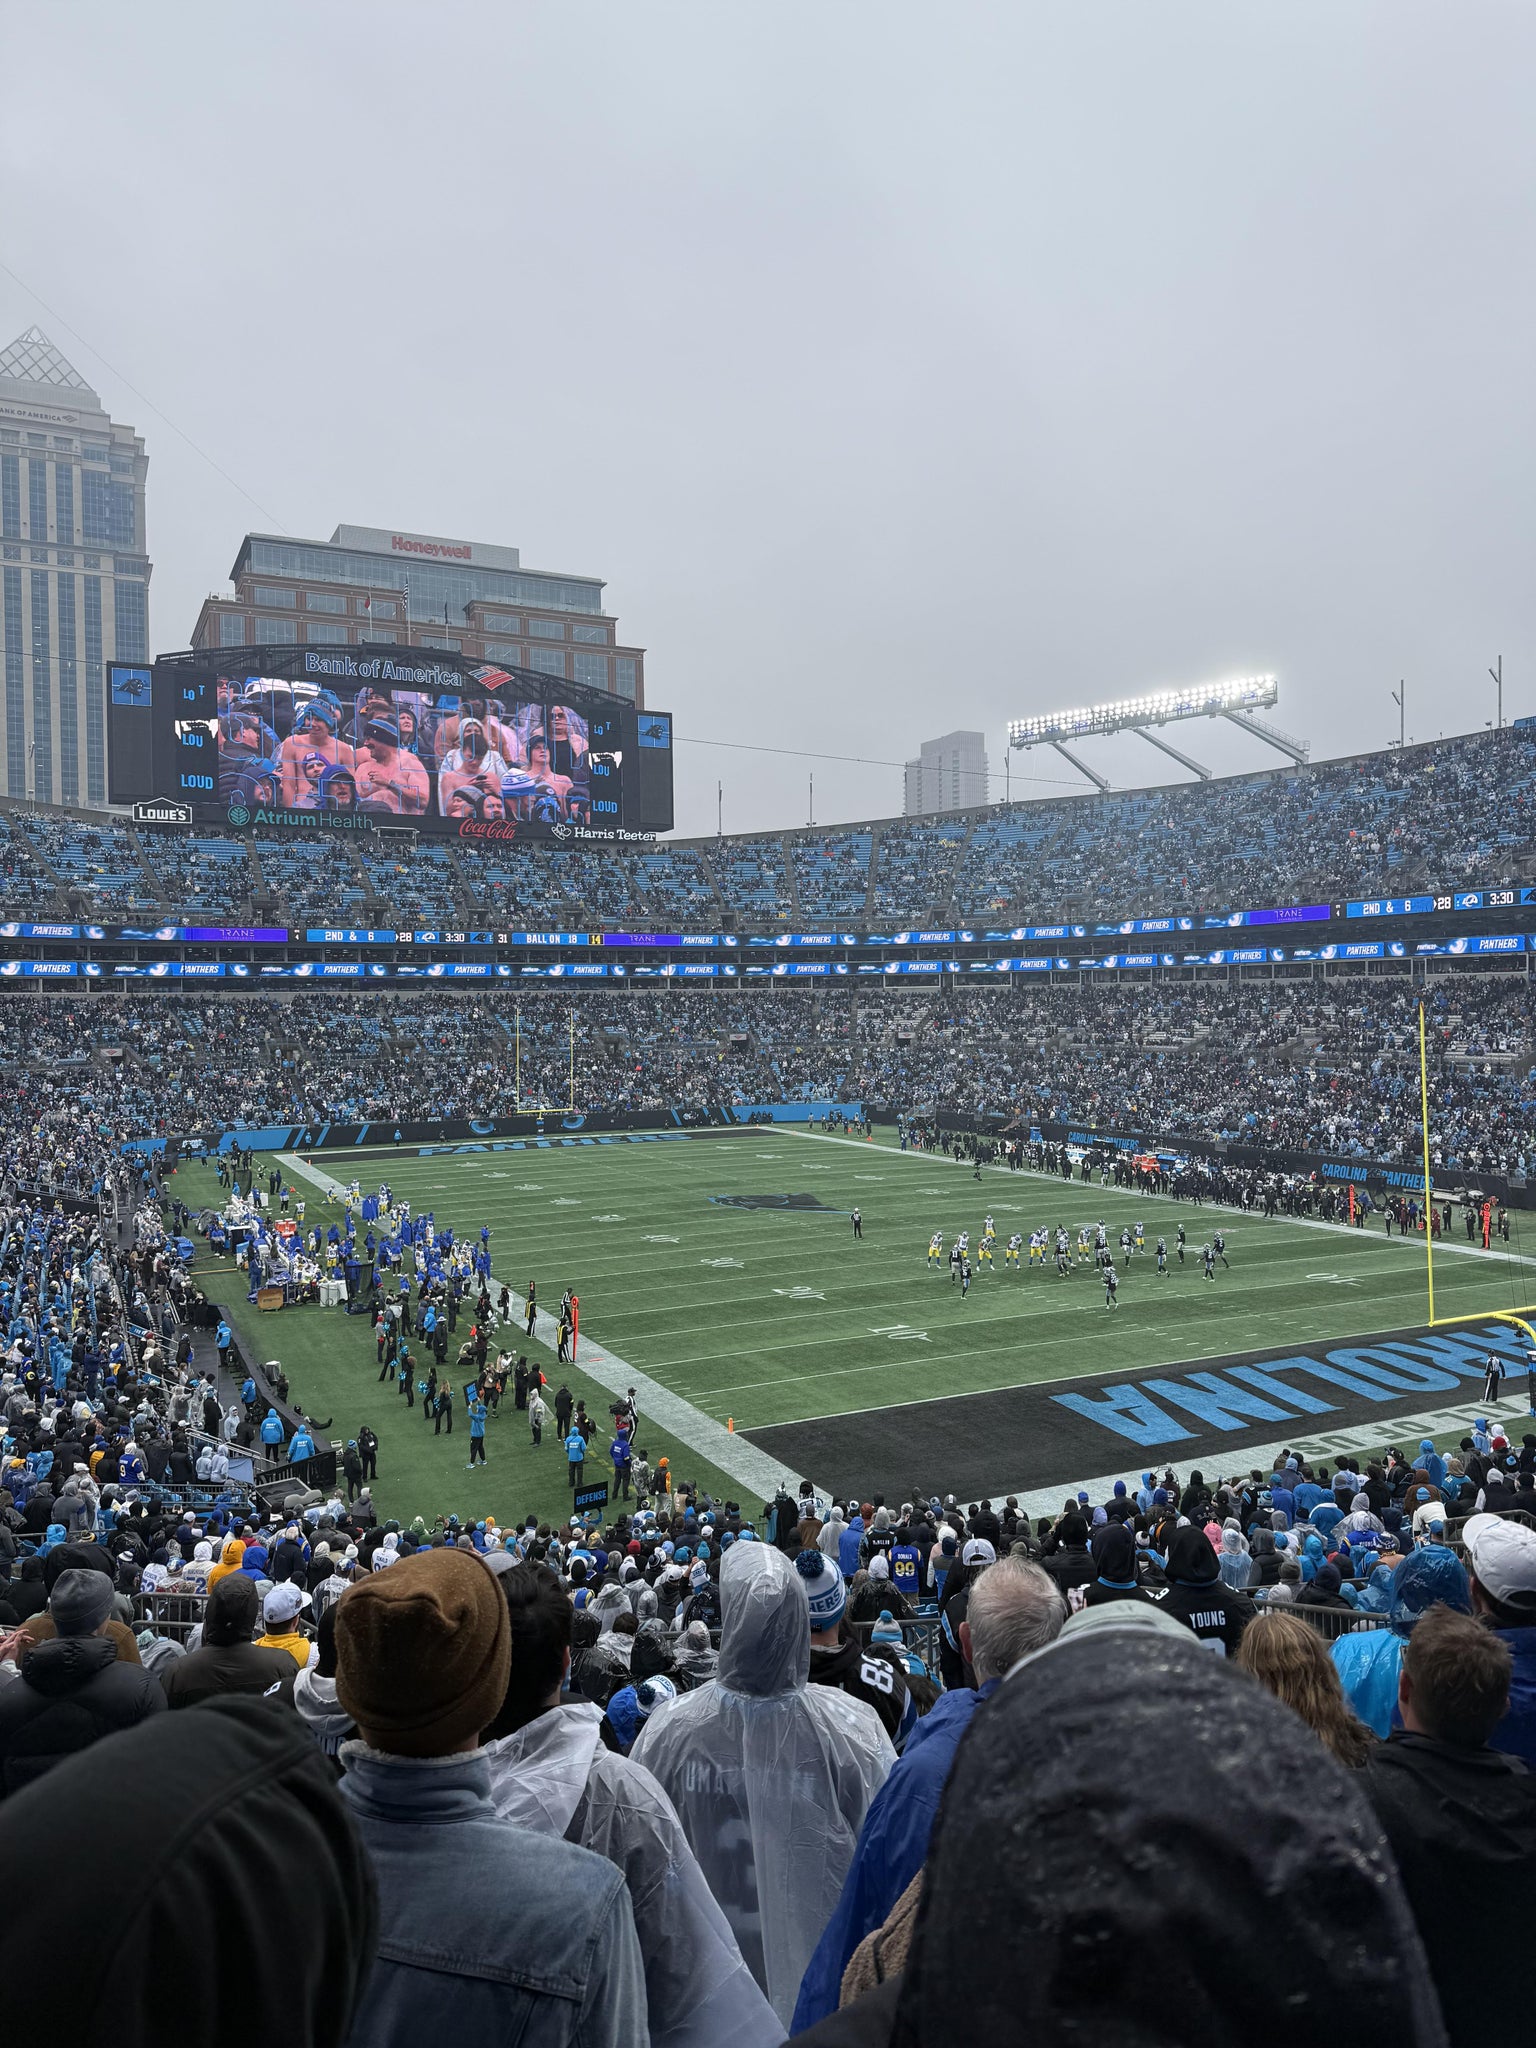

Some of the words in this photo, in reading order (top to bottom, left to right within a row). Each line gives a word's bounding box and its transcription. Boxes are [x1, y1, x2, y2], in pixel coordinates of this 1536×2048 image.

[0, 407, 16, 415] ANK
[28, 411, 62, 422] AMERICA
[391, 535, 472, 559] Honeywell
[305, 652, 358, 677] Bank
[359, 659, 381, 678] of
[382, 661, 462, 687] America
[181, 774, 213, 789] LOUD
[592, 800, 618, 813] LOUD
[139, 806, 187, 821] LOWE'S
[254, 809, 316, 826] Atrium
[319, 812, 374, 829] Health
[574, 827, 615, 840] Harris
[617, 829, 656, 841] Teeter
[1437, 897, 1451, 910] 28
[1489, 892, 1514, 905] 3:30
[1362, 903, 1380, 914] 2ND
[1386, 901, 1394, 913] &
[1404, 900, 1411, 911] 6
[1274, 908, 1303, 918] TRANE
[32, 925, 74, 936] PANTHERS
[1141, 921, 1170, 930] PANTHERS
[219, 929, 255, 937] TRANE
[325, 932, 343, 941] 2ND
[349, 932, 357, 941] &
[400, 932, 412, 942] 28
[445, 932, 465, 942] 3:30
[919, 933, 950, 941] PANTHERS
[1034, 927, 1064, 937] PANTHERS
[498, 933, 508, 943] 31
[526, 934, 547, 943] BALL
[550, 934, 560, 943] ON
[569, 934, 577, 943] 18
[591, 935, 600, 944] 14
[683, 936, 713, 944] PANTHERS
[800, 936, 831, 944] PANTHERS
[1479, 938, 1519, 949] PANTHERS
[1233, 951, 1262, 960] PANTHERS
[1346, 946, 1379, 956] PANTHERS
[1020, 960, 1048, 968] PANTHERS
[1125, 957, 1153, 965] PANTHERS
[33, 964, 71, 974] PANTHERS
[180, 965, 219, 974] PANTHERS
[324, 965, 359, 974] PANTHERS
[454, 965, 487, 974] PANTHERS
[574, 966, 602, 974] PANTHERS
[418, 1133, 692, 1157] PANTHERS
[1322, 1163, 1368, 1181] CAROLINA
[1049, 1320, 1536, 1447] AROLINA
[1372, 1421, 1435, 1441] OF
[1288, 1435, 1367, 1456] US
[576, 1489, 607, 1506] DEFENSE
[895, 1561, 915, 1577] 99
[809, 1588, 840, 1613] HERS
[1189, 1610, 1226, 1630] YOUNG
